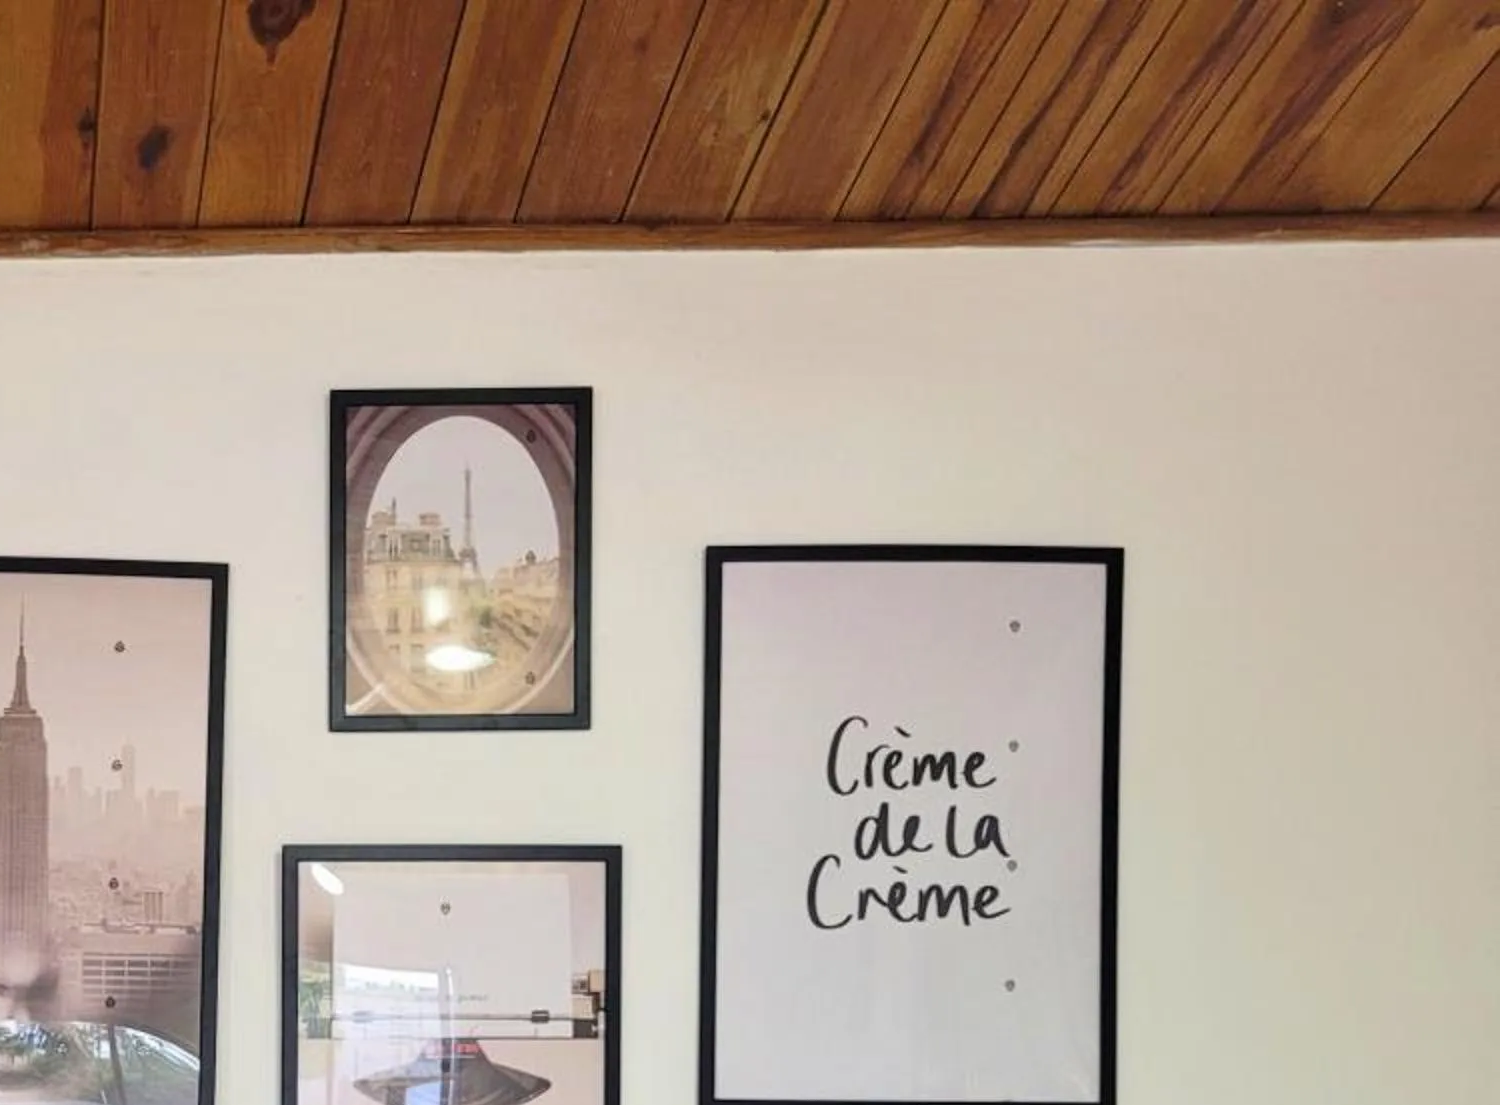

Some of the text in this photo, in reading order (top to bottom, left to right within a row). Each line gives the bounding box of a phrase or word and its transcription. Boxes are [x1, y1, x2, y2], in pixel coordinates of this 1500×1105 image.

[826, 715, 997, 796] Crème
[854, 801, 1012, 861] de la
[806, 853, 1012, 930] Crème
